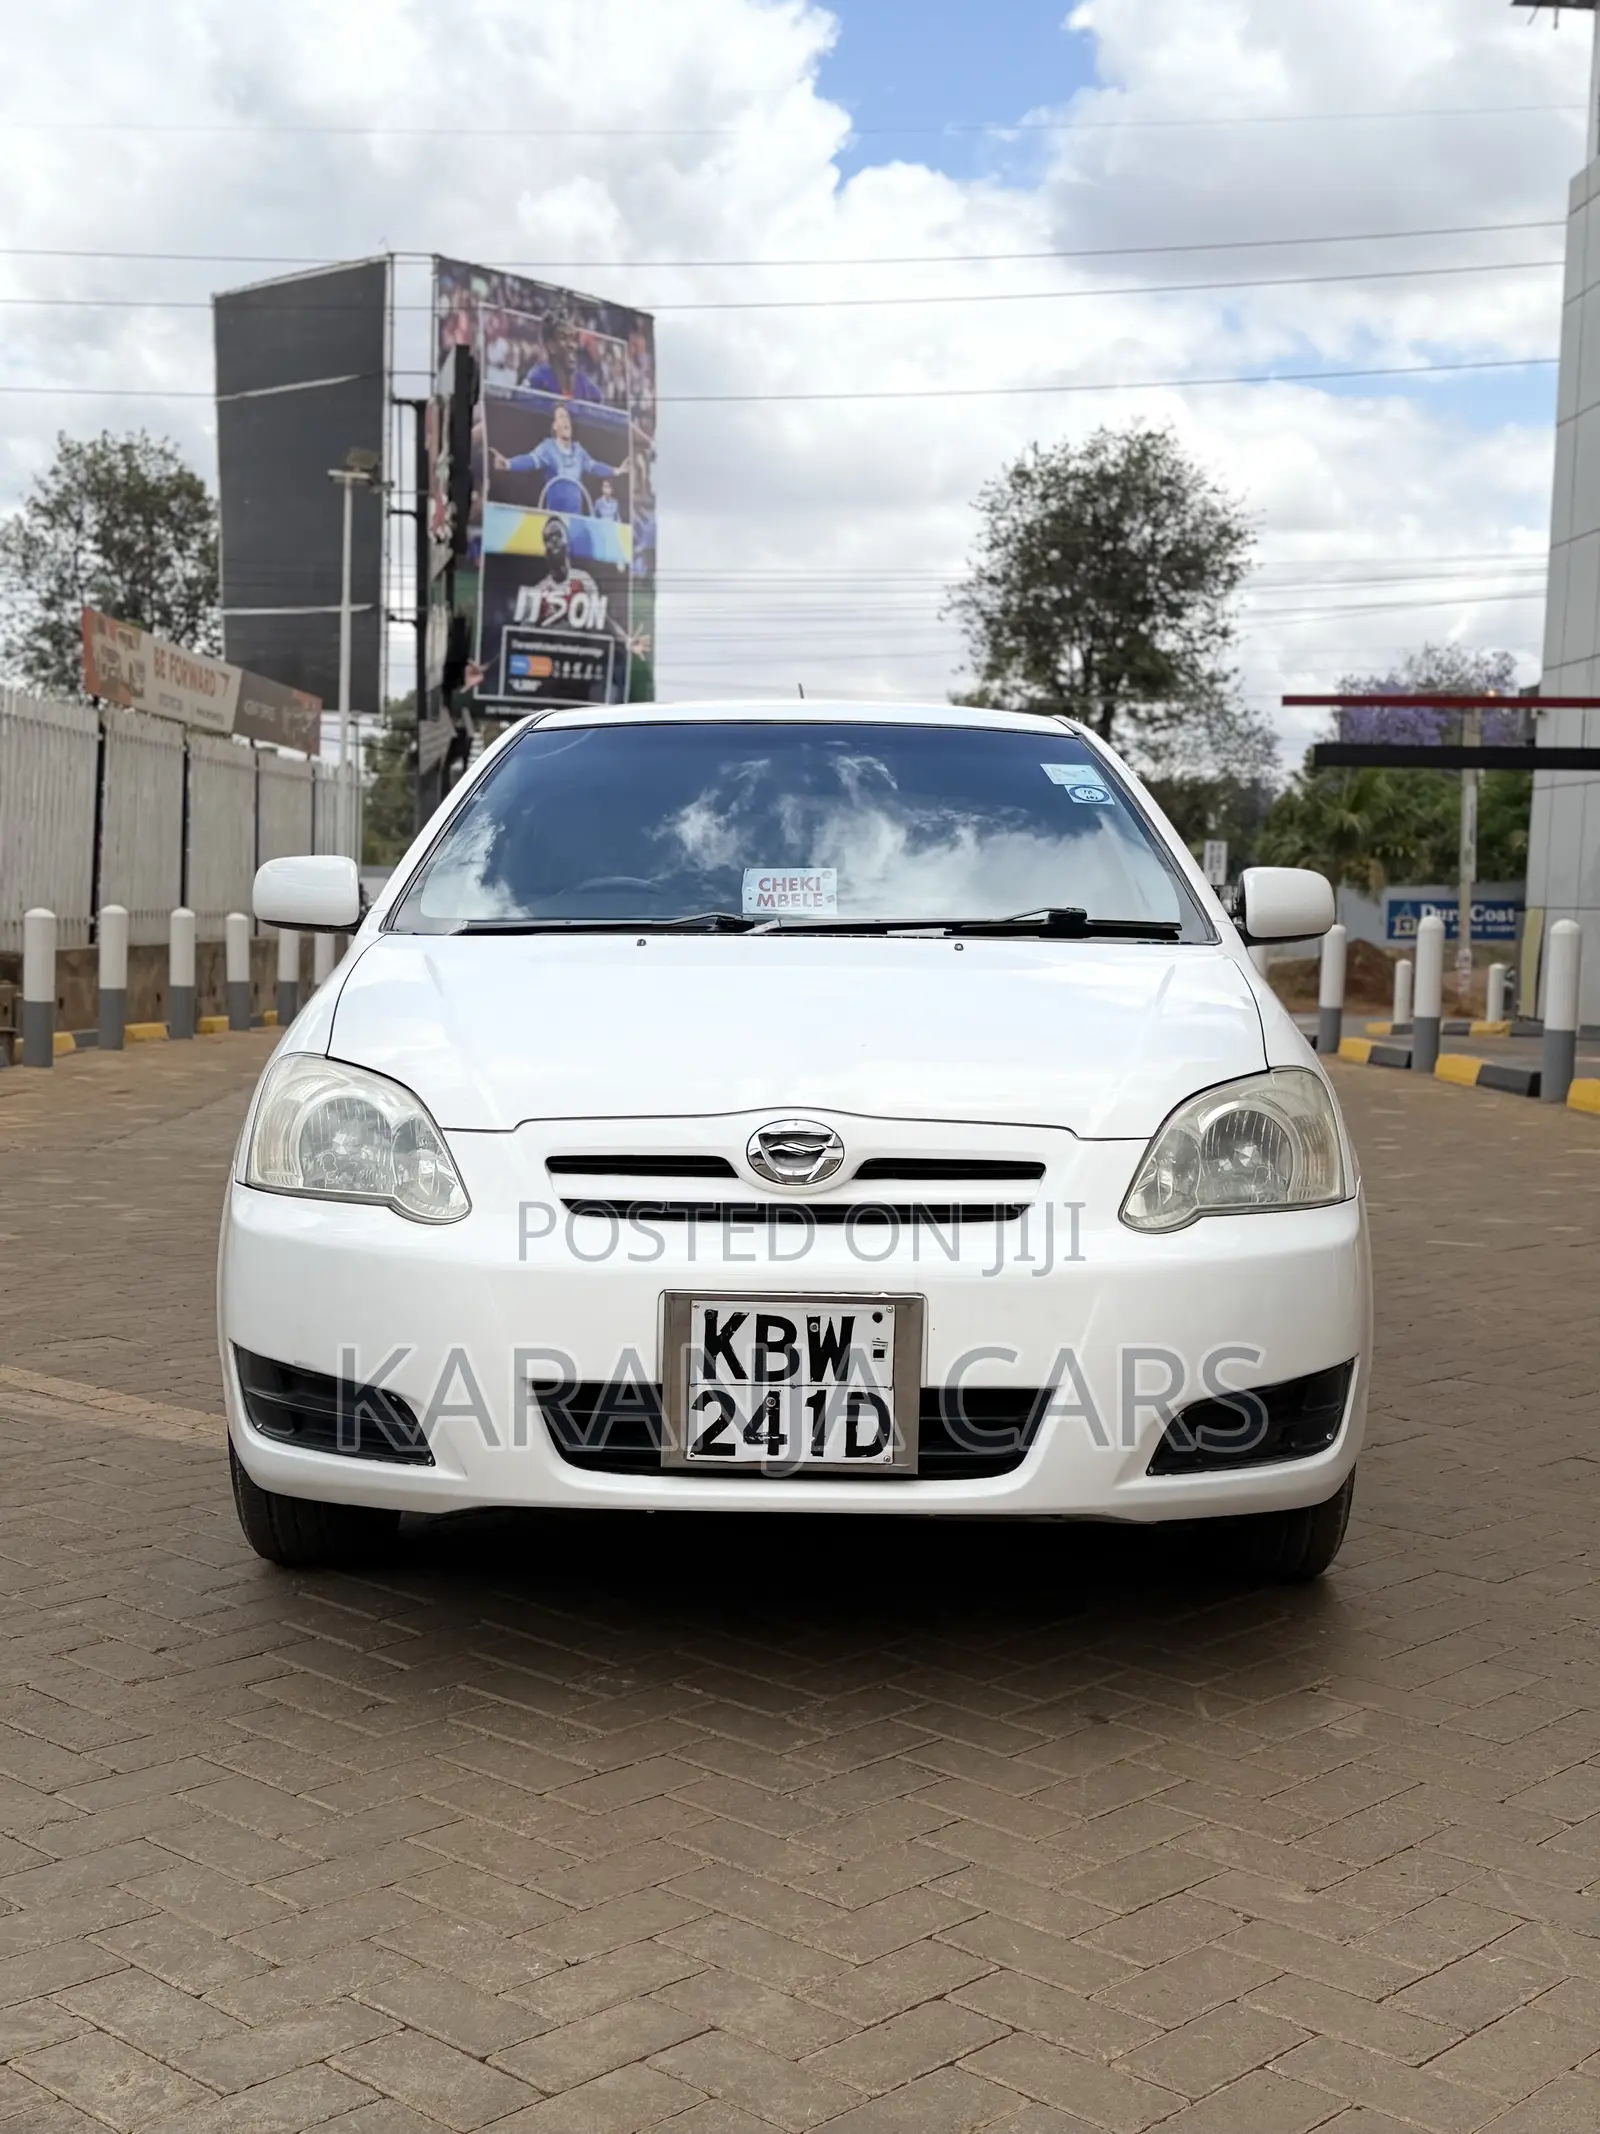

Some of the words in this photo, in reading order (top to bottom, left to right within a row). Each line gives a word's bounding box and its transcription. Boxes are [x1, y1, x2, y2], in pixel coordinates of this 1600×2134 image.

[568, 592, 608, 630] ON
[154, 646, 166, 680] BE
[170, 653, 216, 698] FORWARD
[756, 893, 823, 908] MBELE
[758, 877, 821, 892] CHEKI
[703, 1309, 857, 1383] KBW
[690, 1389, 892, 1459] 241D
